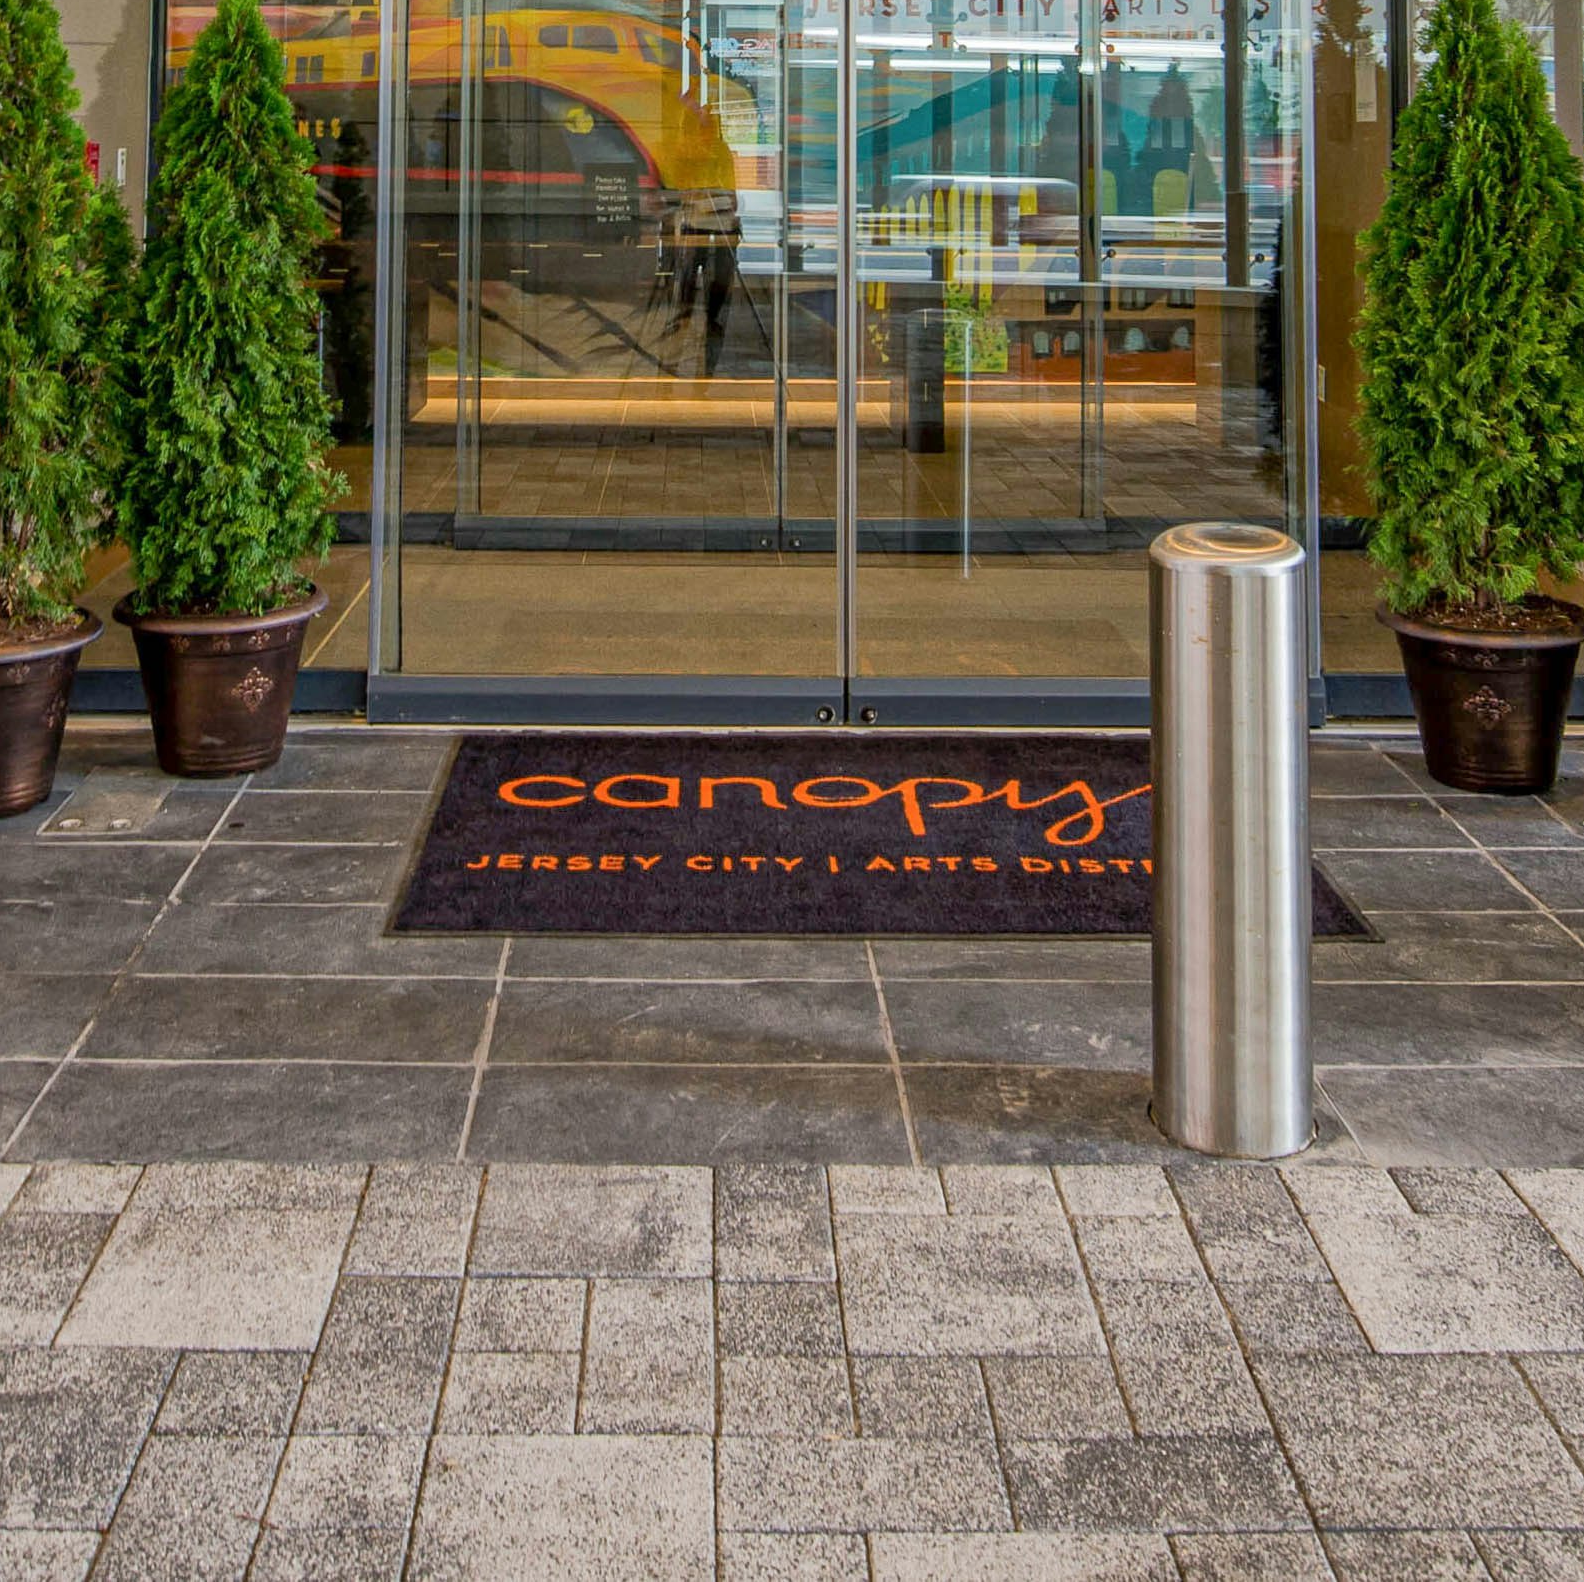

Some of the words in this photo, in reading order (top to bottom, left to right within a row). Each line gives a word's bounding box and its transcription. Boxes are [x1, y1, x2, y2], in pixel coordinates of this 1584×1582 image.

[497, 774, 1153, 846] canopy
[466, 854, 663, 872] JERSEY
[685, 855, 804, 873] CITY
[866, 855, 999, 873] ARTS
[1019, 856, 1153, 875] DIST
